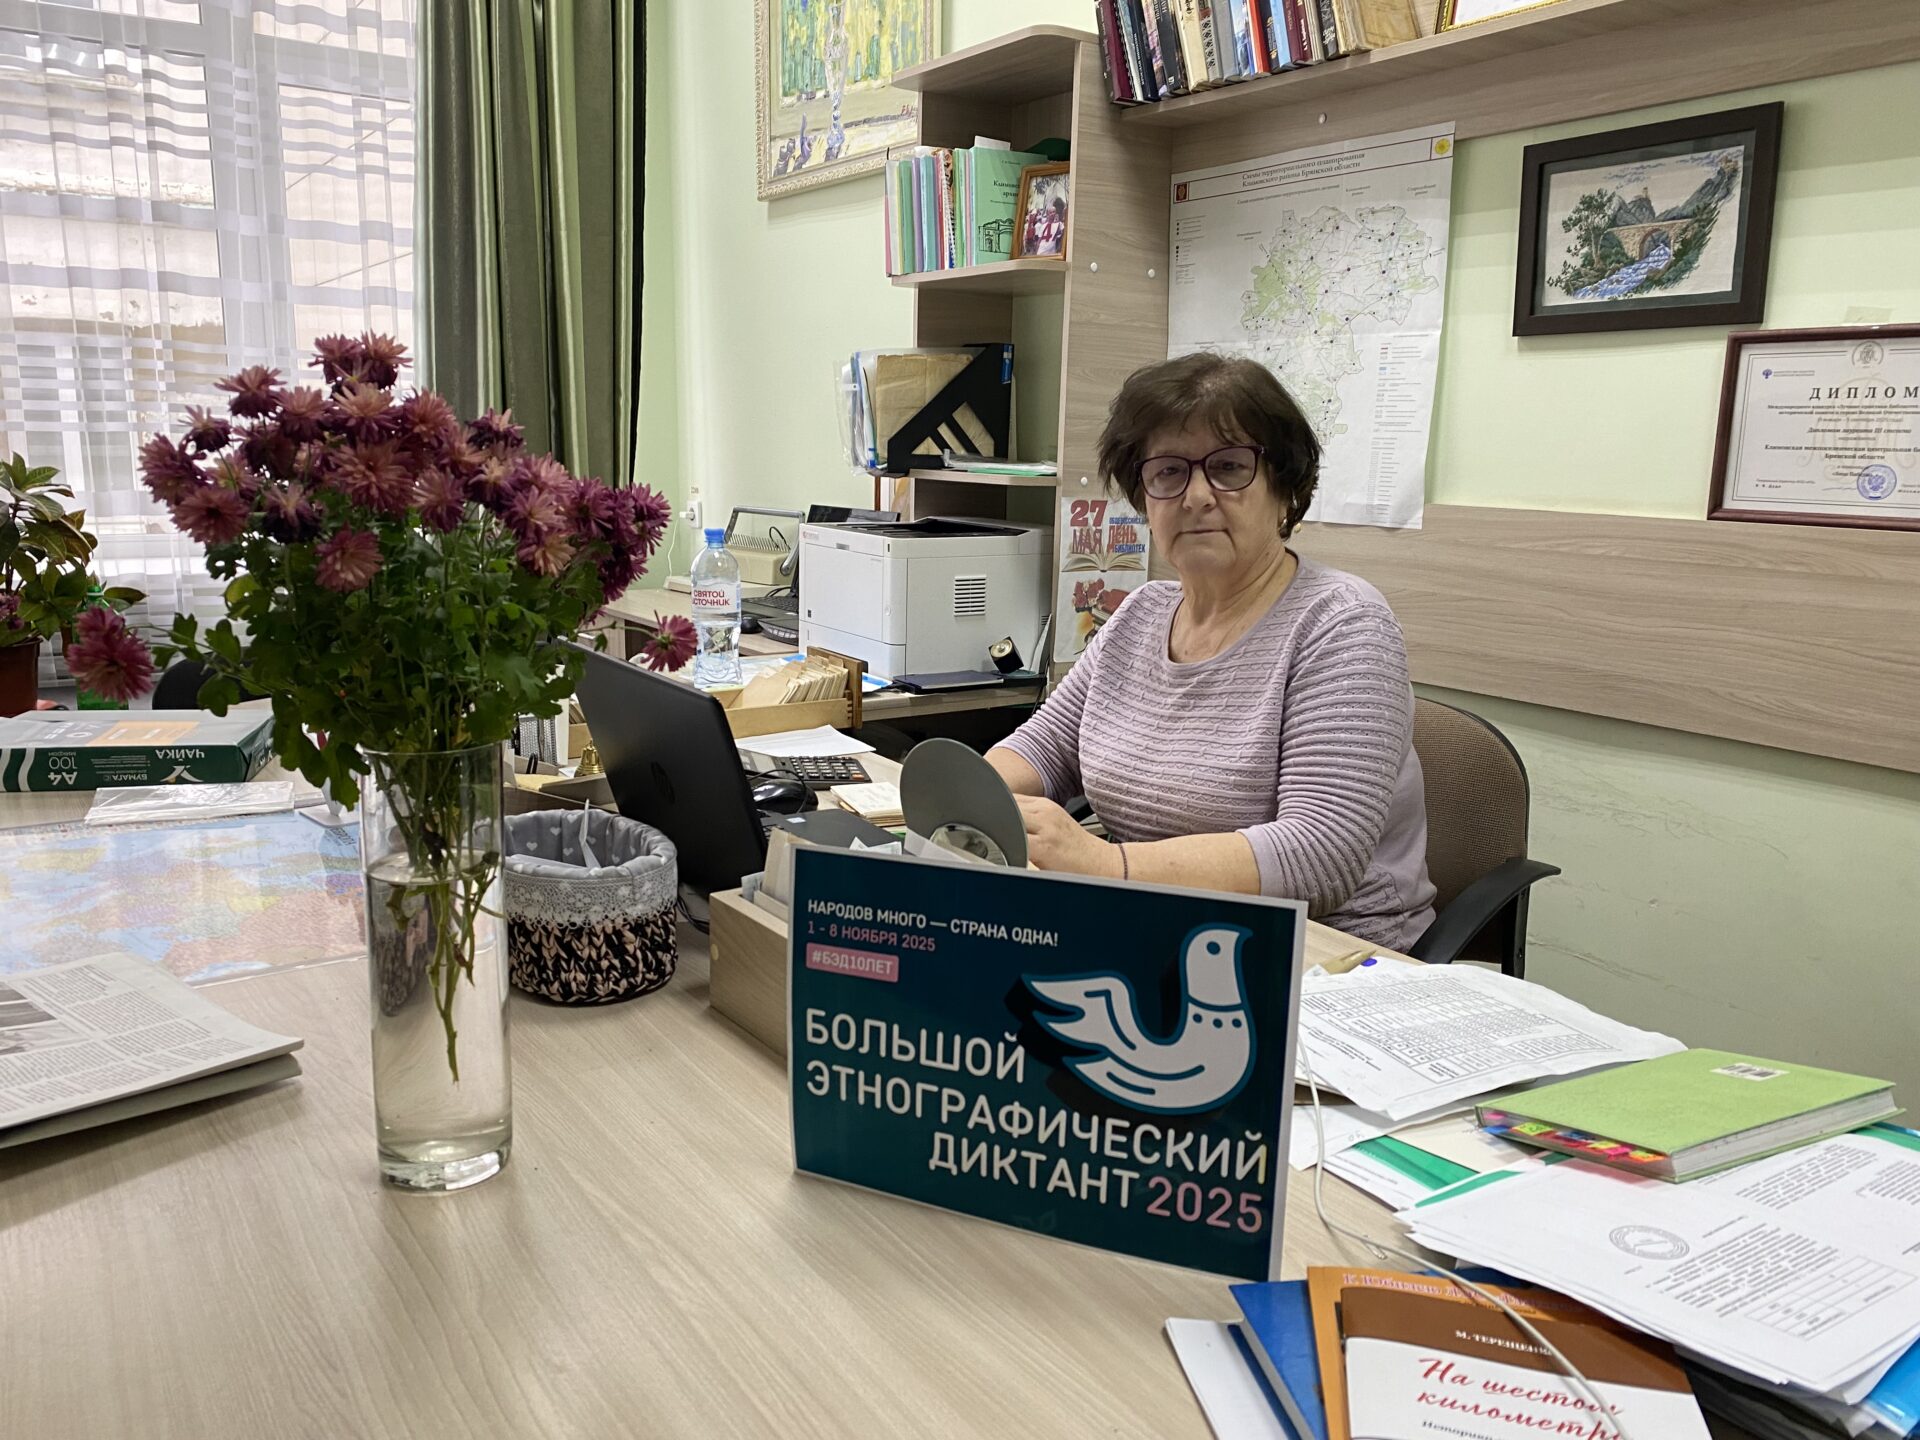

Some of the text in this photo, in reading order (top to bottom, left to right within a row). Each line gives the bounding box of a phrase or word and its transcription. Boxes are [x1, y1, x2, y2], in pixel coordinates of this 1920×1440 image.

[1809, 385, 1920, 401] ДИПЛОМ
[1070, 499, 1108, 527] 27
[1072, 529, 1103, 554] МАЯ
[1107, 525, 1137, 552] ДЕНЬ
[693, 588, 725, 598] СВЯТОЙ
[48, 757, 78, 770] 100
[155, 749, 205, 762] ЧАЙКА
[48, 771, 78, 786] A4
[112, 774, 148, 782] БУМАГА
[807, 899, 873, 921] НАРОДОВ
[876, 908, 927, 929] МНОГО
[950, 918, 1008, 940] СТРАНА
[1011, 926, 1059, 948] ОДНА!
[807, 920, 815, 935] 1
[829, 924, 838, 938] 8
[841, 925, 898, 946] НОЯБРЯ
[902, 934, 936, 951] 2025
[812, 949, 894, 975] #БЭД10ЛЕТ
[805, 1007, 1026, 1084] БОЛЬШОЙ
[806, 1059, 1268, 1185] ЭТНОГРАФИЧЕСКИЙ
[928, 1132, 1263, 1234] ДИКТАНТ 2025
[1455, 1329, 1471, 1340] М.
[1418, 1357, 1475, 1387] На
